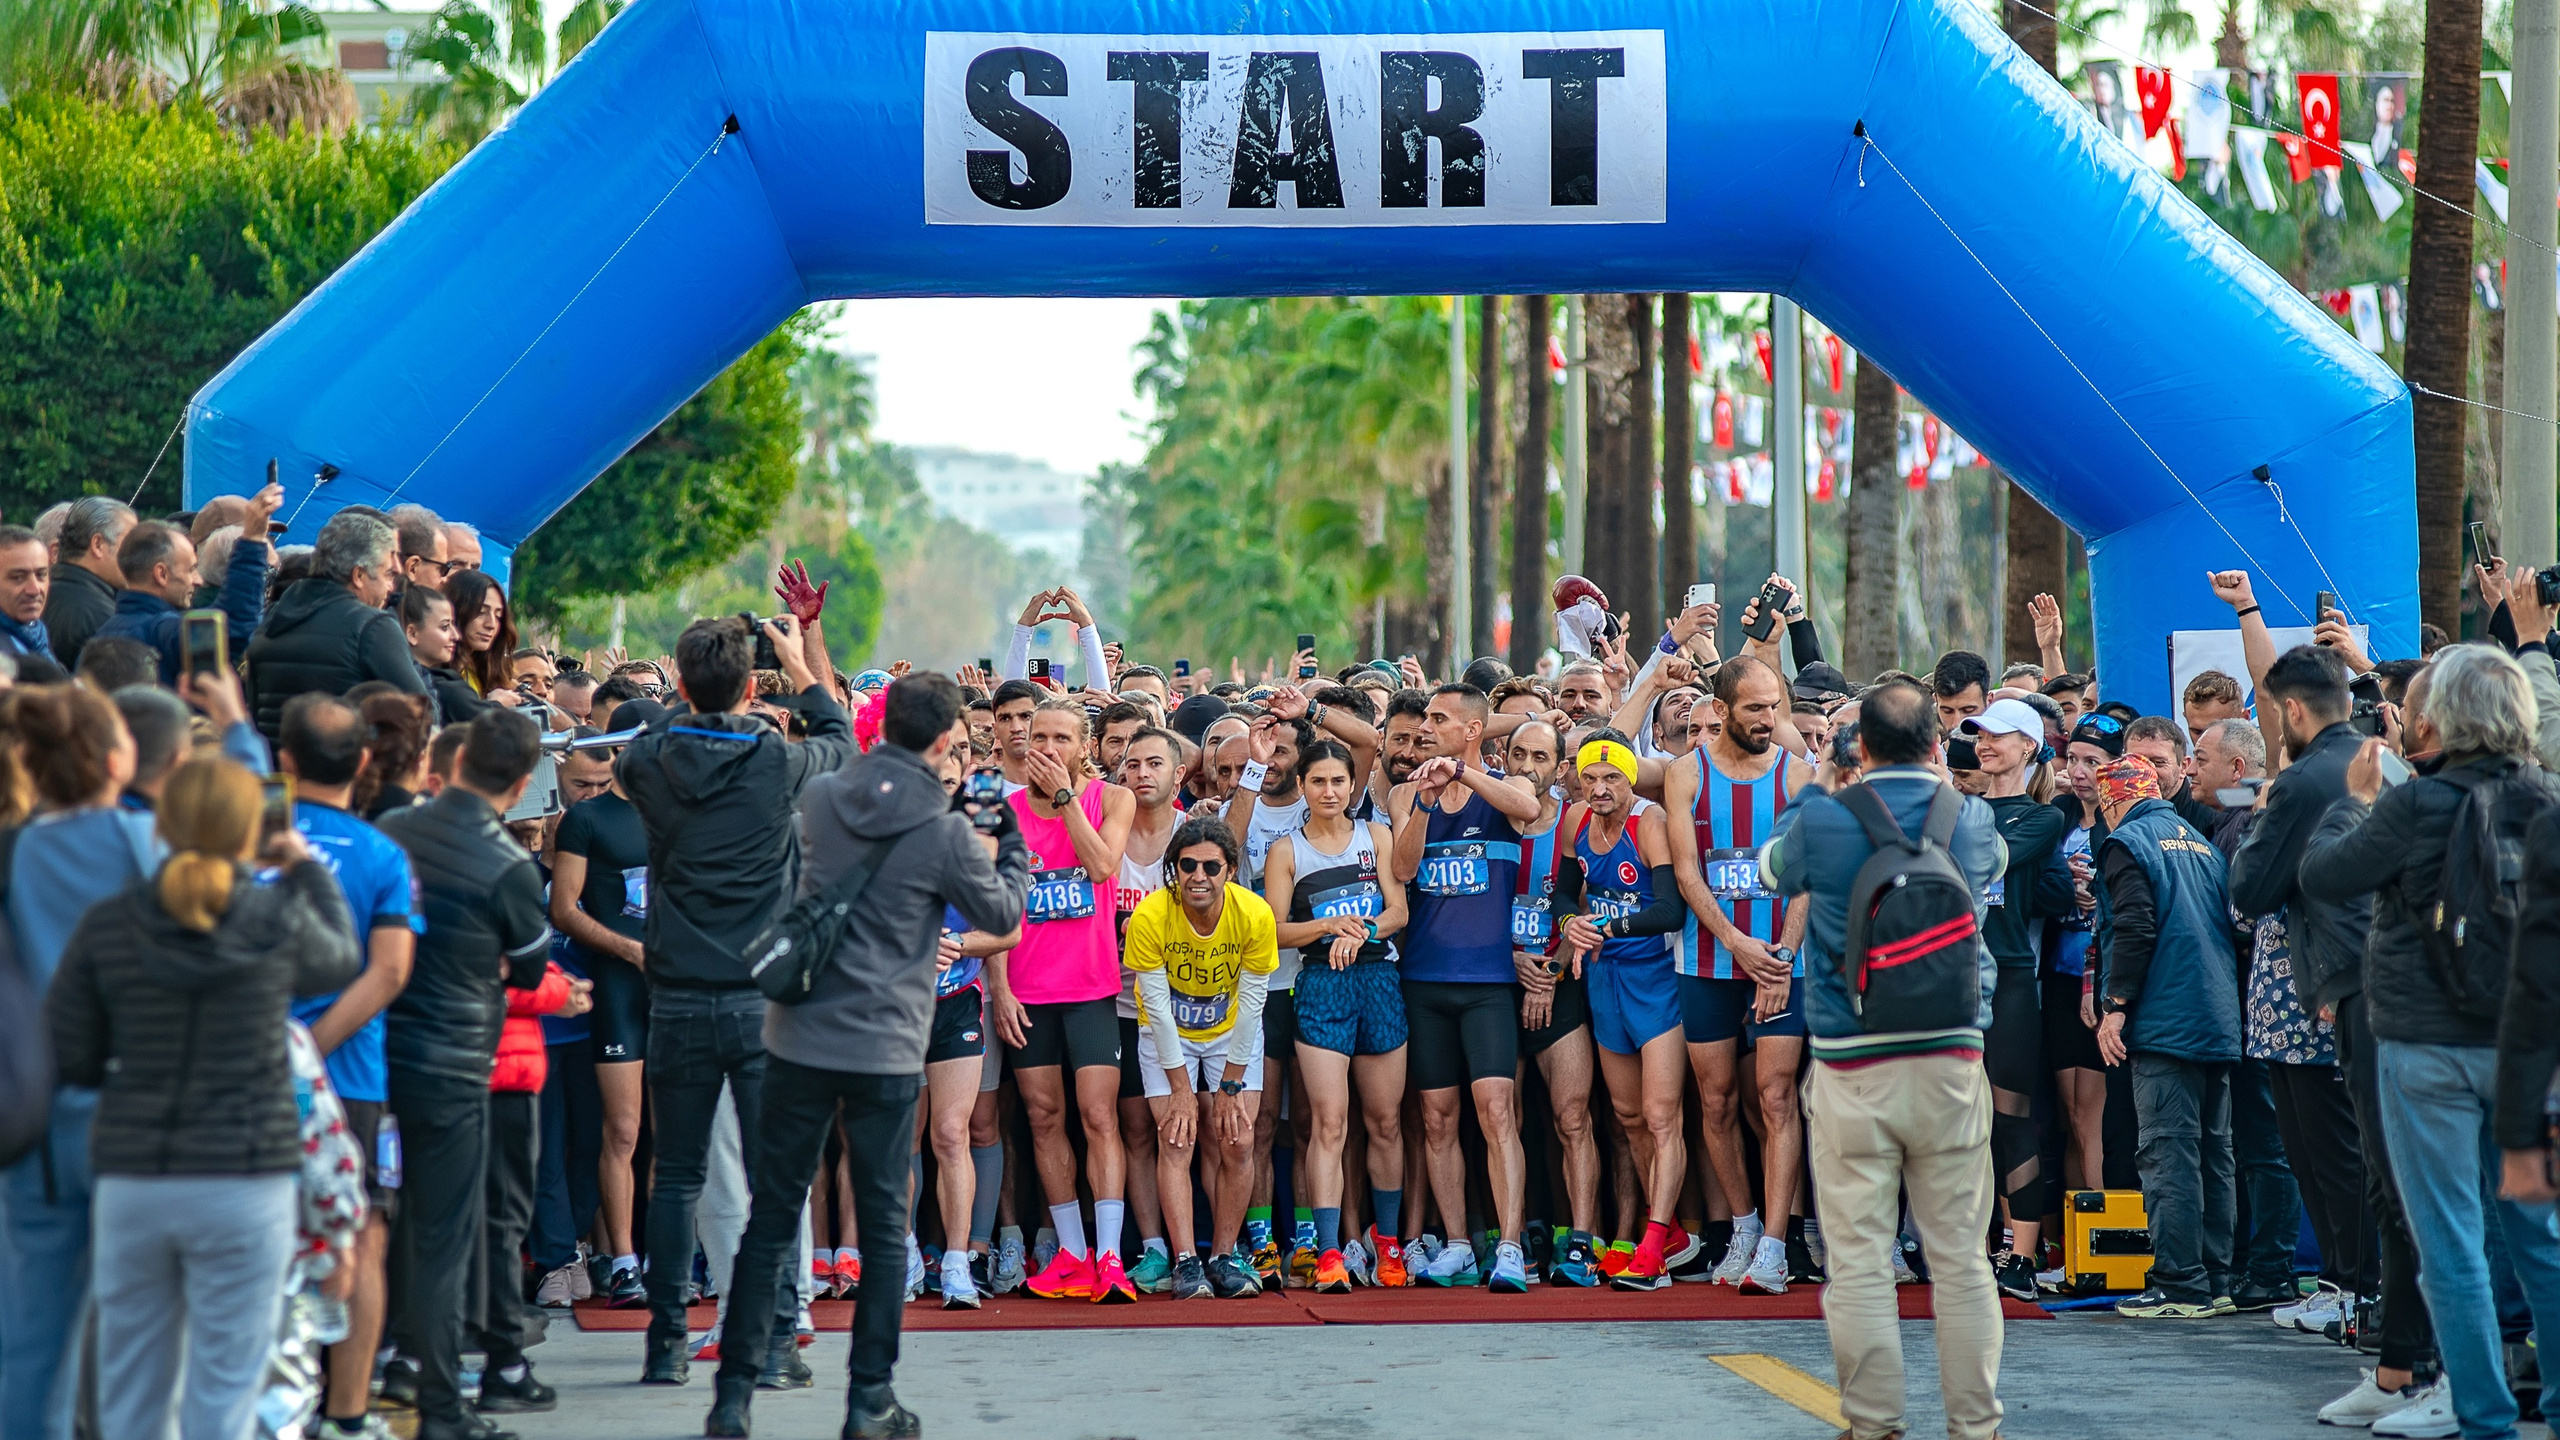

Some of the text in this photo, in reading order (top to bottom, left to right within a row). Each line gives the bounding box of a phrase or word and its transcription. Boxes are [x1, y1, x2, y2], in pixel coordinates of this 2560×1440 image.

[964, 46, 1625, 209] START
[1428, 860, 1475, 887] 2103
[1480, 882, 1486, 890] K
[1032, 882, 1082, 913] 2136
[1077, 905, 1094, 916] 10 K
[1514, 910, 1540, 937] 68
[1542, 936, 1549, 944] K
[1171, 999, 1217, 1024] 1079
